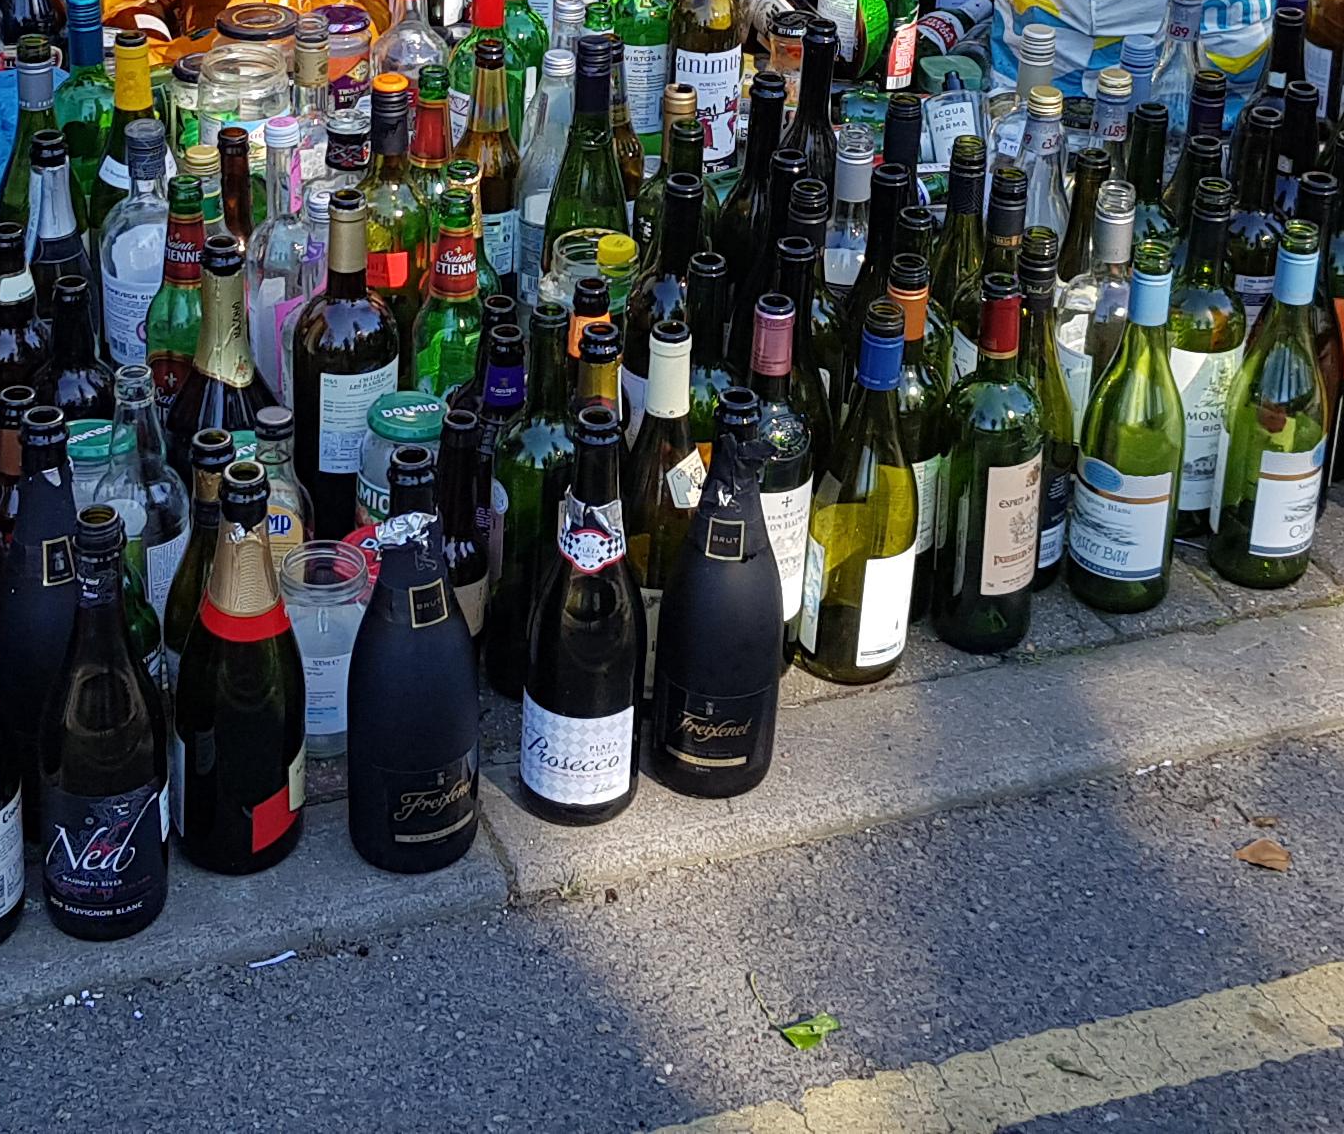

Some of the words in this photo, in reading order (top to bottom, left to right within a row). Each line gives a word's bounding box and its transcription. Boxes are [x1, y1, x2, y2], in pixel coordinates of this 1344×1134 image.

[933, 106, 966, 120] ACQUA
[442, 250, 474, 264] Sainte
[435, 261, 477, 277] ETIENNE
[380, 401, 440, 418] DOLMIO
[712, 535, 739, 546] BRUT
[674, 711, 750, 744] Freixenet
[525, 735, 621, 774] Prosecco
[45, 791, 158, 872] Ned
[64, 902, 114, 917] SAUVIGNON
[115, 899, 144, 915] BLANC
